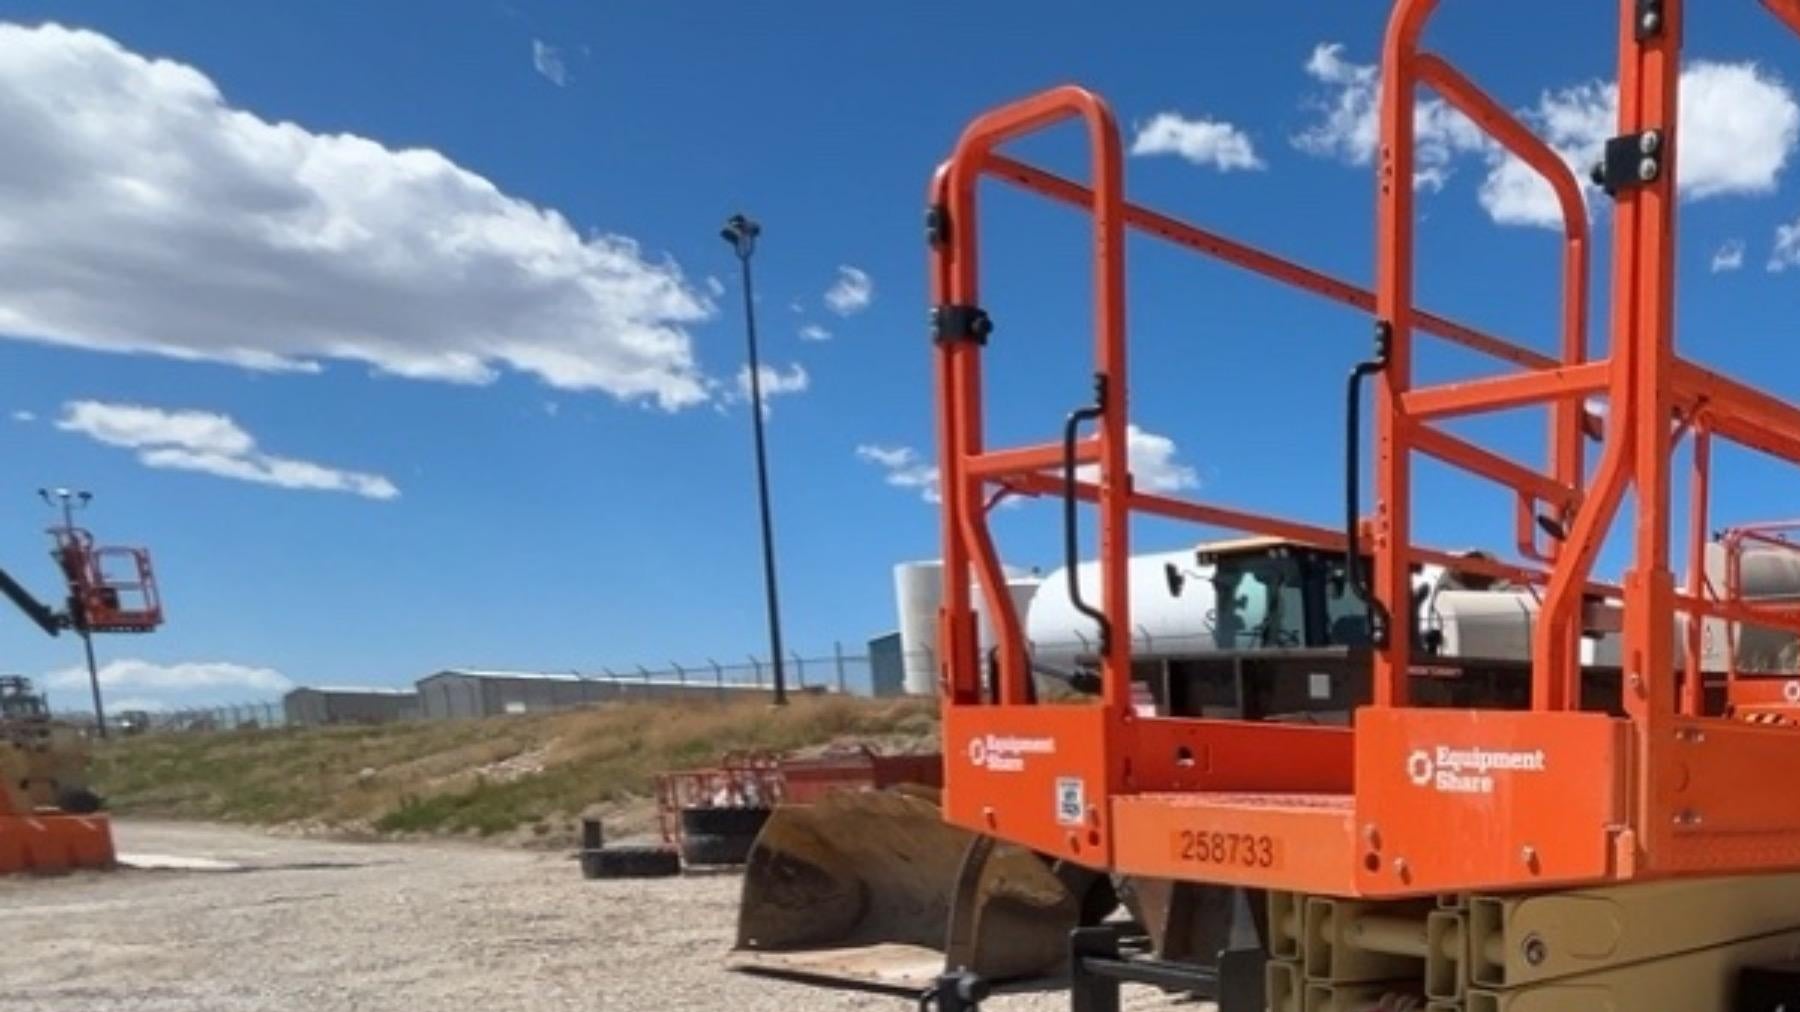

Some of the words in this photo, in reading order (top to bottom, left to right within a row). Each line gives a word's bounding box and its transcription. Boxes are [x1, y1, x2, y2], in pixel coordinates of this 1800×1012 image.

[1436, 746, 1545, 775] Equipment
[1436, 770, 1494, 793] Share
[1181, 830, 1273, 868] 258733
